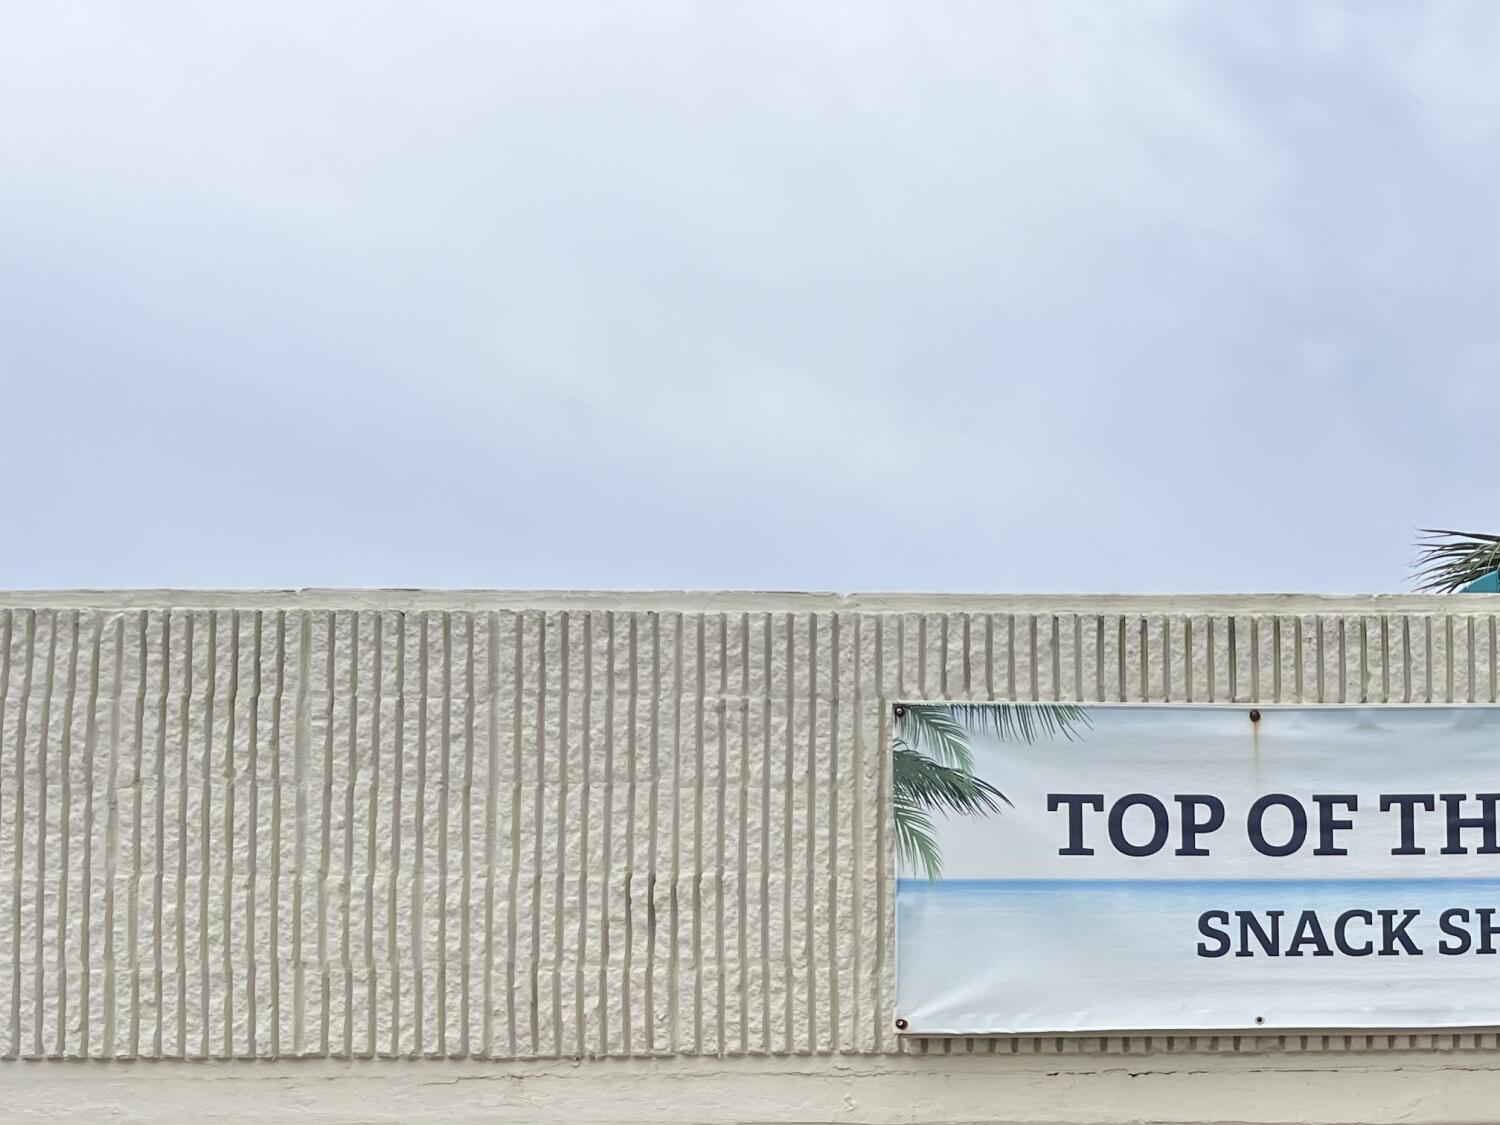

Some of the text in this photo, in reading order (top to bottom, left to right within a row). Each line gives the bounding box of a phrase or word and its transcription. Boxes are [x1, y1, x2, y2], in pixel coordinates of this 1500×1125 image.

[1046, 793, 1225, 858] TOP
[1246, 793, 1359, 858] OF
[1197, 909, 1424, 958] SNACK
